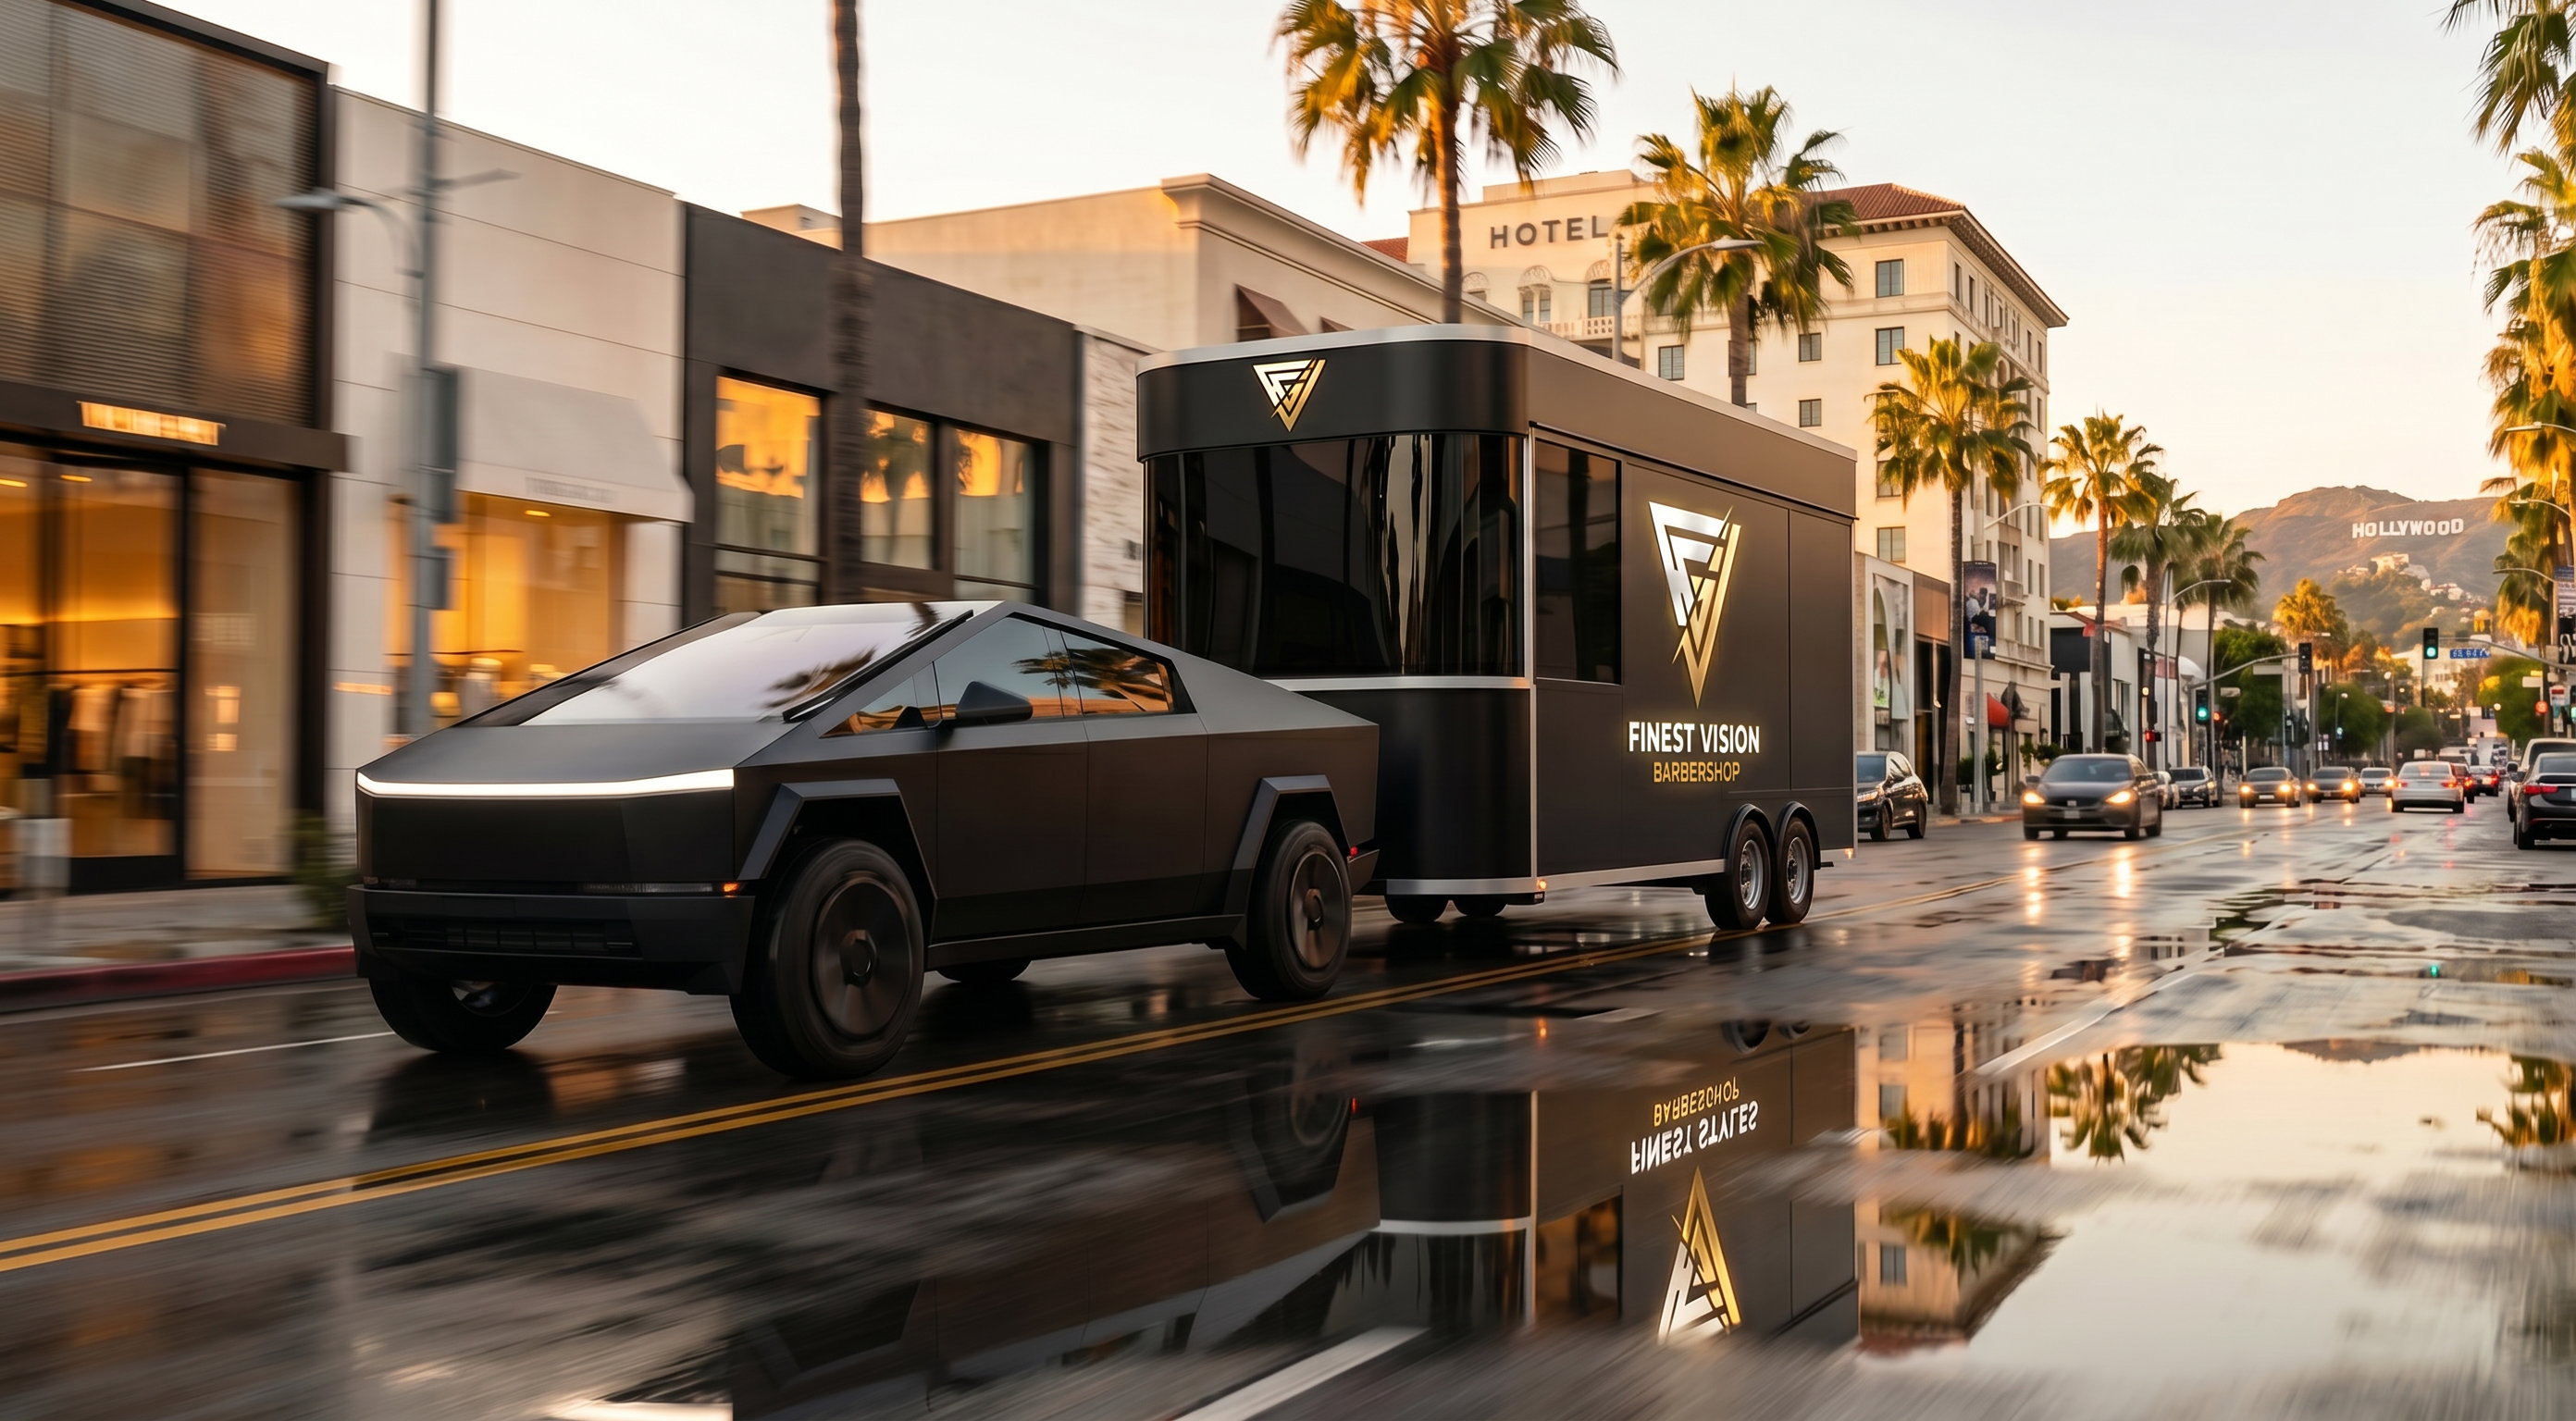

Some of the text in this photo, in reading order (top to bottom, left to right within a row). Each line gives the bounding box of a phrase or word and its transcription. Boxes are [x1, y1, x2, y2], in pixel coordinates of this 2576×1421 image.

[1490, 215, 1609, 250] HOTEL
[2351, 518, 2464, 539] HOLLYWOOD
[1629, 721, 1760, 754] FINEST VISION
[1653, 760, 1740, 783] BARBERSHOP
